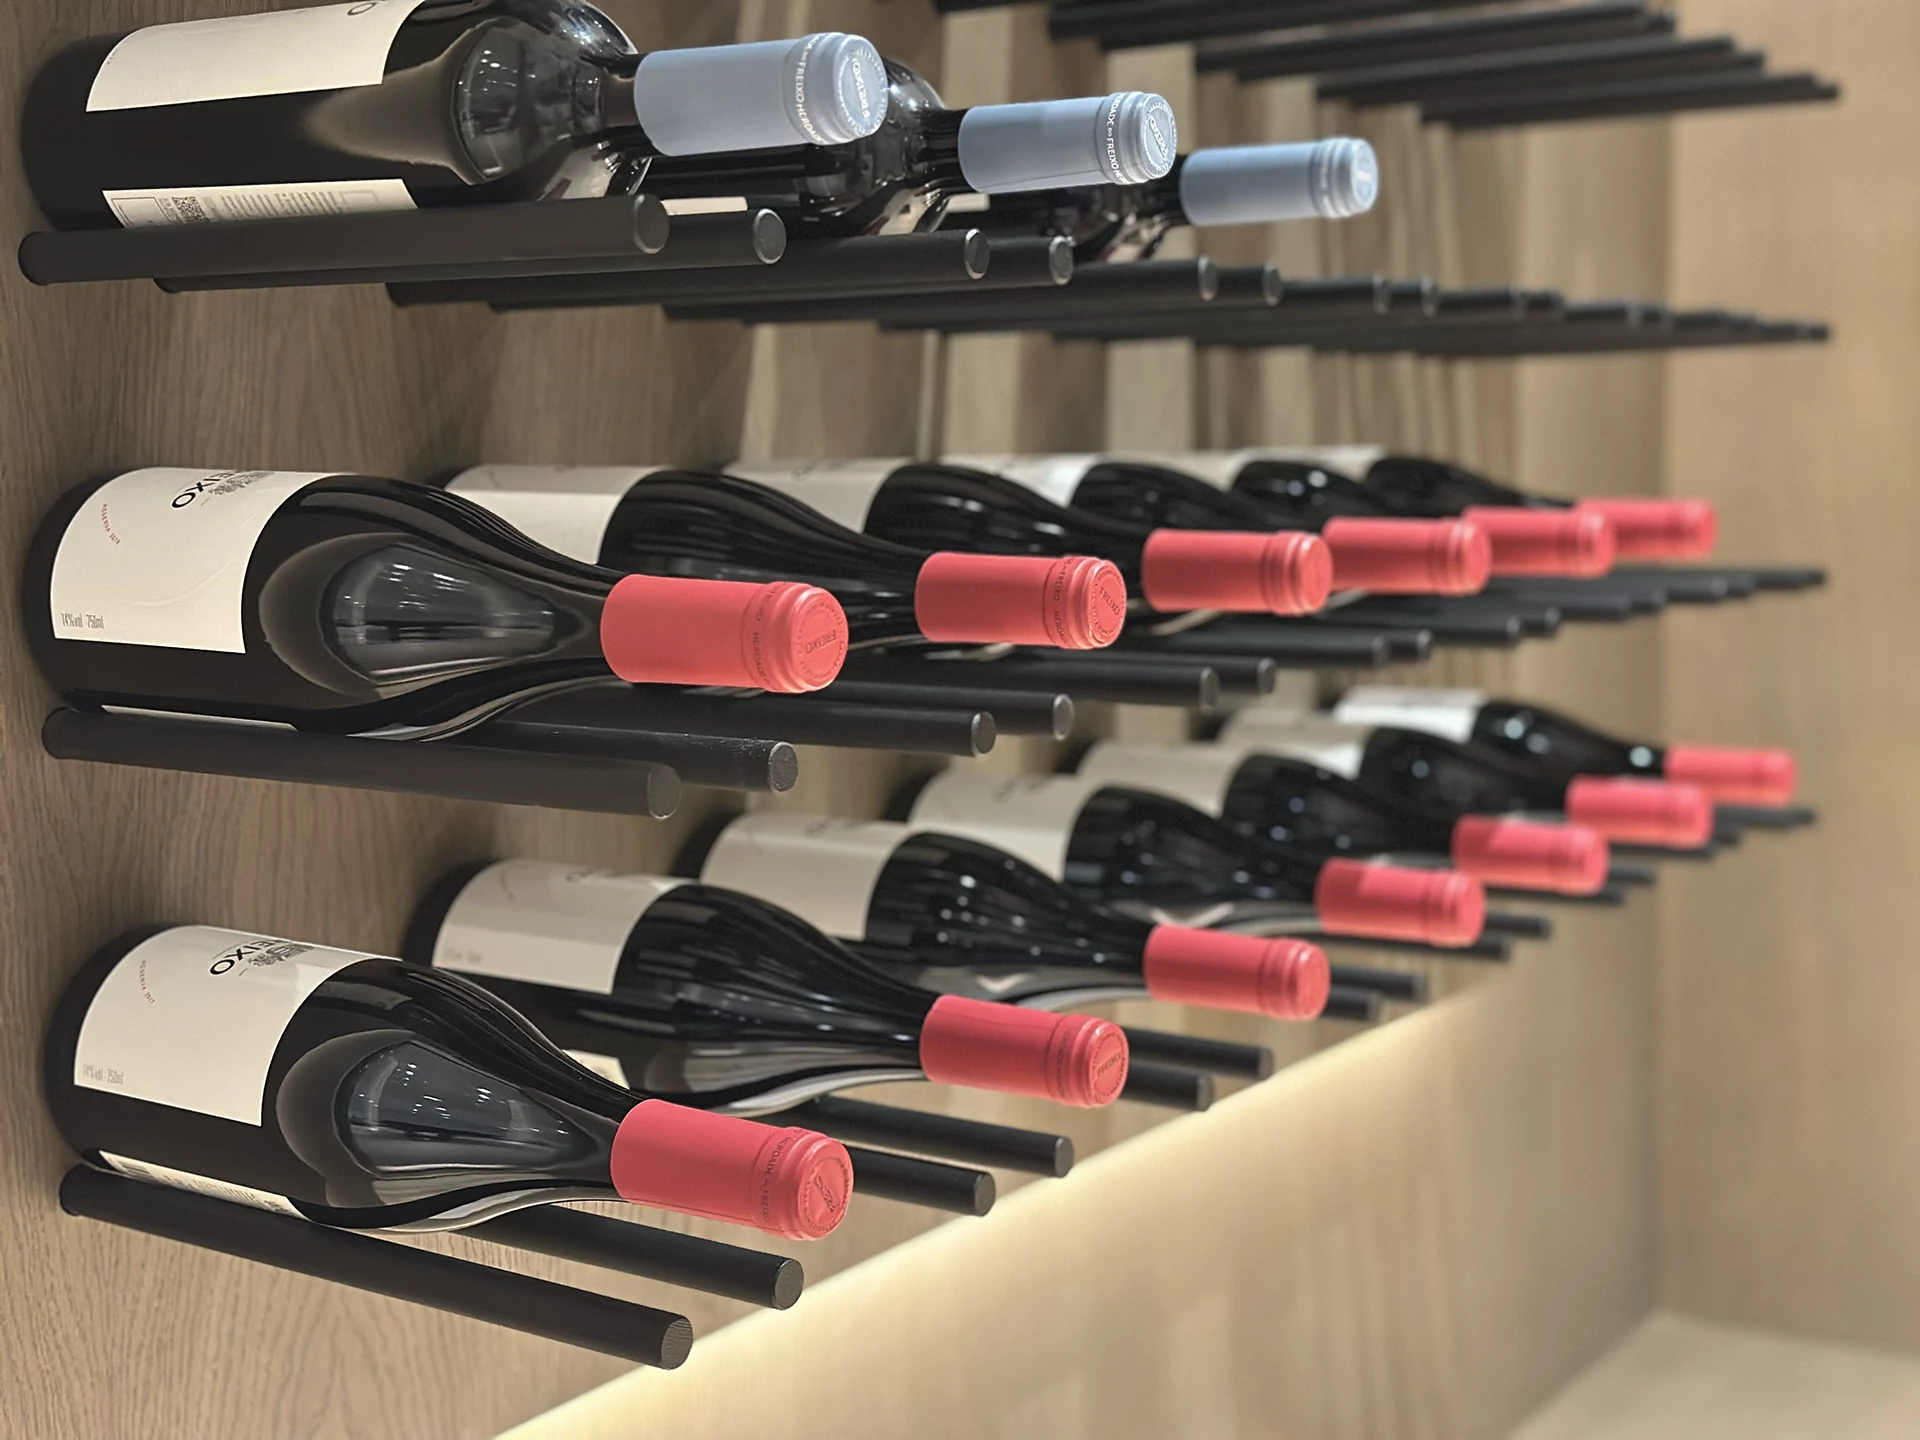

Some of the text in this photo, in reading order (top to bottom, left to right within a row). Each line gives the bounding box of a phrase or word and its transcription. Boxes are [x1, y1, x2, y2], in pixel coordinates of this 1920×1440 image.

[795, 61, 806, 103] FREIXO
[1106, 138, 1120, 170] FREIXO
[171, 471, 240, 509] EIXO
[1099, 587, 1121, 616] FREIXO
[805, 629, 837, 655] FREIXO
[209, 938, 280, 976] EIXO
[764, 1136, 793, 1177] HERDADE
